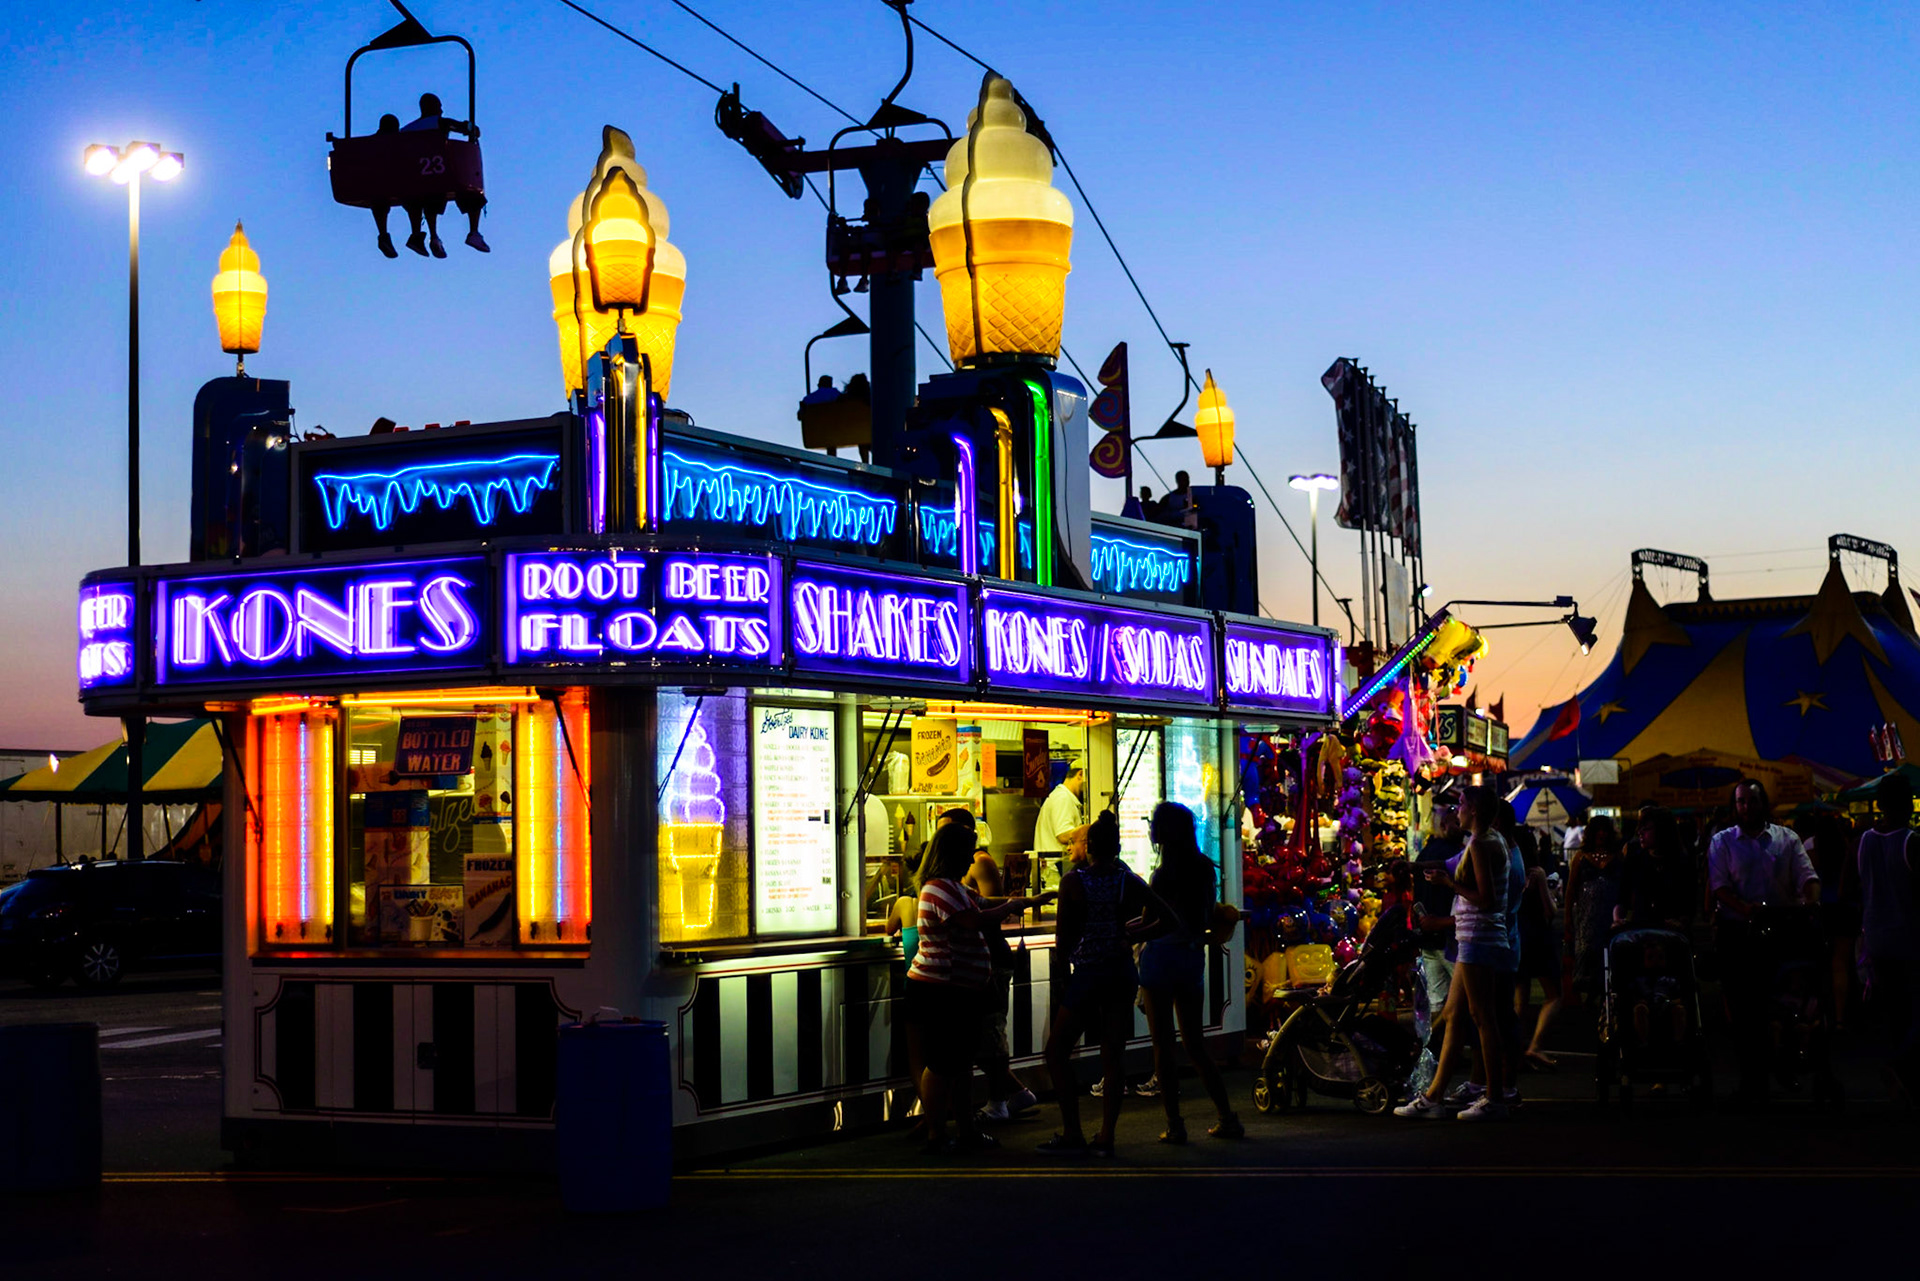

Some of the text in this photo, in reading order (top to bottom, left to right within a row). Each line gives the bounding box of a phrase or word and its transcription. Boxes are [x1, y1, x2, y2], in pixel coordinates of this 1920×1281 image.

[418, 155, 446, 176] 23
[522, 562, 770, 604] ROOT BEER
[174, 576, 478, 664] KONES
[520, 612, 771, 655] FLOATS
[793, 582, 961, 667] SHAKES
[985, 608, 1088, 680] KONES
[1121, 626, 1206, 691] SODAS
[1225, 638, 1323, 700] SUNDAES
[401, 729, 471, 750] BOTTLED
[788, 725, 829, 741] DAIRY KONE
[917, 730, 942, 740] FROZEN
[407, 752, 461, 772] WATER
[466, 859, 513, 871] FROZEN
[468, 876, 511, 908] BANANAS
